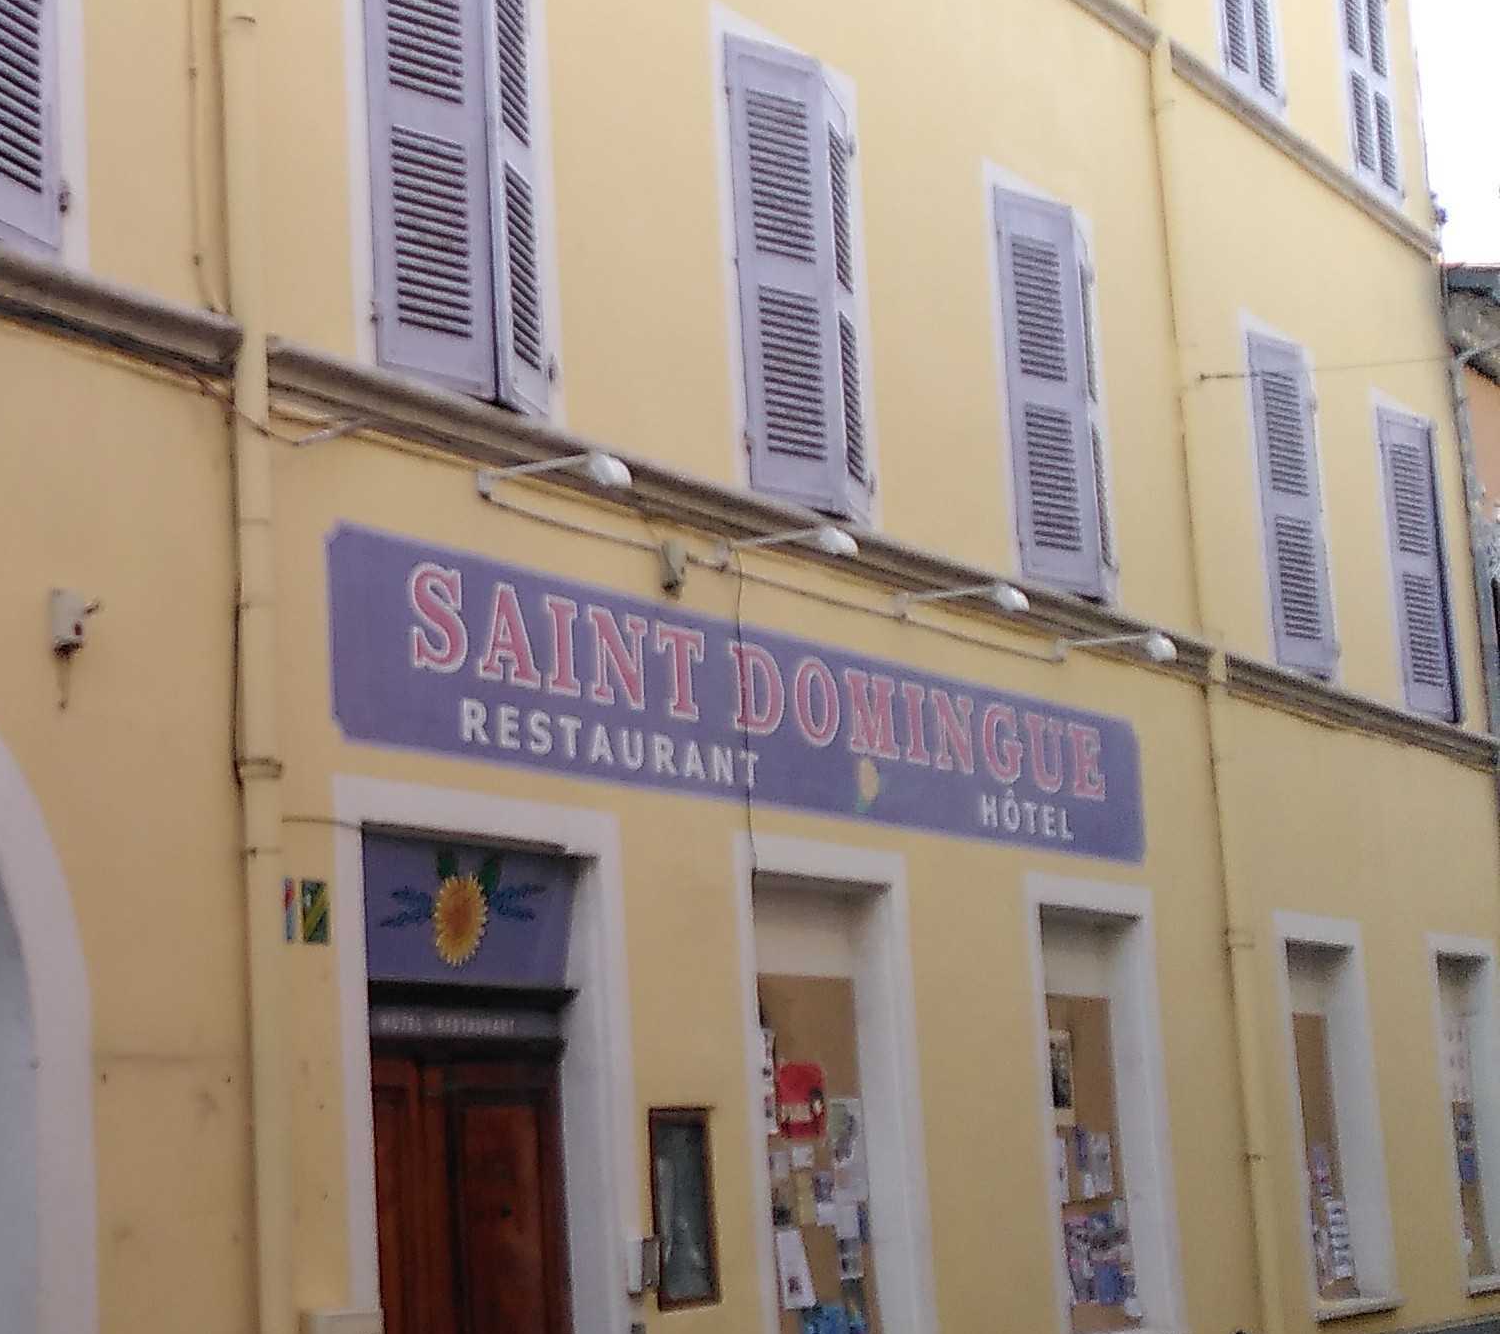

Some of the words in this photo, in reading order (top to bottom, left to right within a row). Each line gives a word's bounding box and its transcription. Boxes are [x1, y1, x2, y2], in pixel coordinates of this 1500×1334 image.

[410, 562, 705, 720] SAINT
[729, 640, 1106, 801] DOMINGUE
[460, 698, 759, 788] RESTAURANT
[981, 788, 1075, 842] HÔTEL
